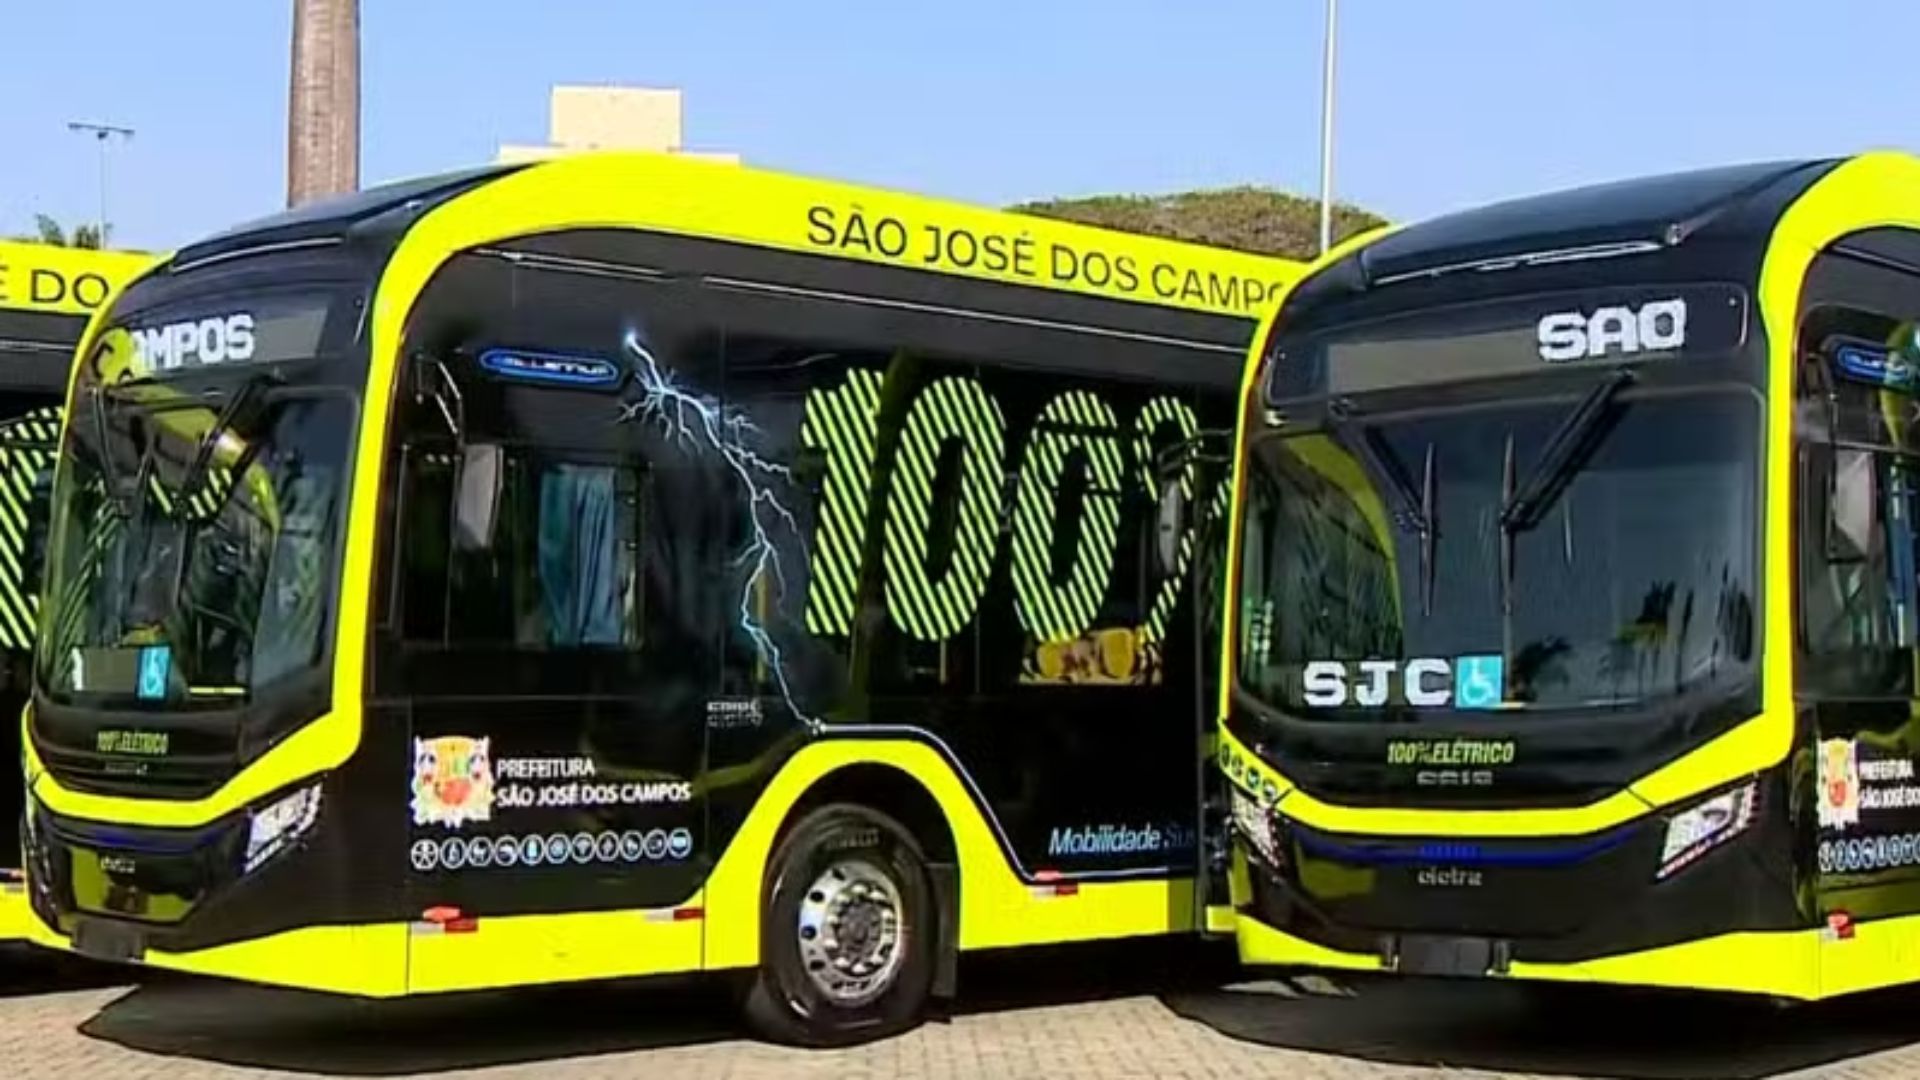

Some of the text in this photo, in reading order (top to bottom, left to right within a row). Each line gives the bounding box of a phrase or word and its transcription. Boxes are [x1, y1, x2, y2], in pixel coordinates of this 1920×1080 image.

[807, 203, 908, 258] SÃO
[923, 224, 1035, 278] JOSÉ
[1051, 243, 1139, 293] DOS
[1538, 297, 1687, 360] SAO
[1303, 658, 1452, 706] SJC
[497, 757, 595, 779] PREFEITURA
[497, 780, 692, 807] SÃO JOSÉ DOS CAMPOS
[1048, 821, 1161, 856] Mobilidade
